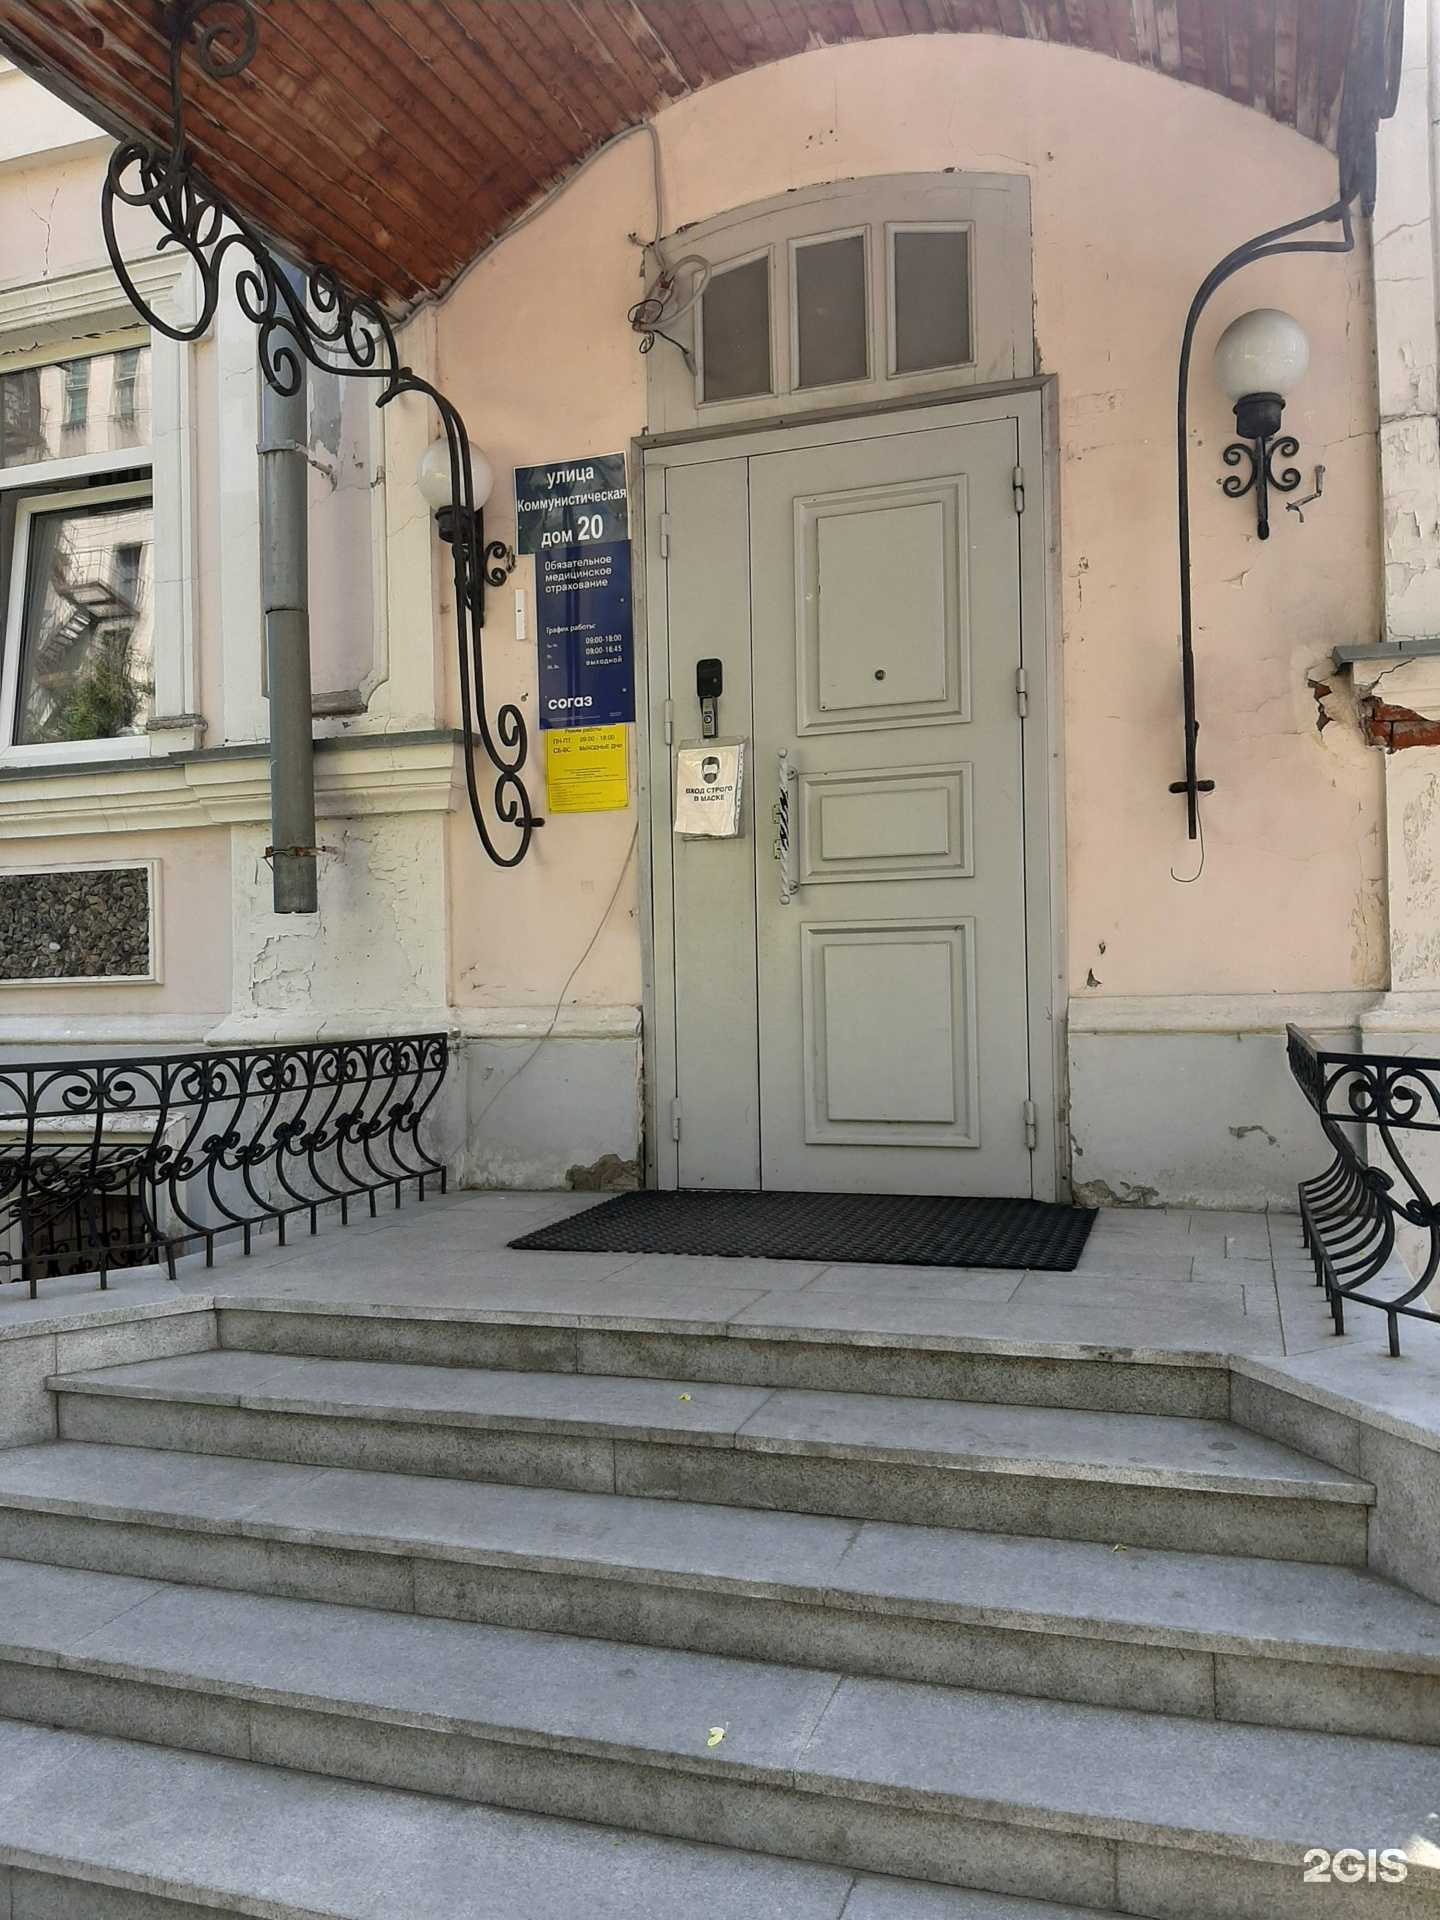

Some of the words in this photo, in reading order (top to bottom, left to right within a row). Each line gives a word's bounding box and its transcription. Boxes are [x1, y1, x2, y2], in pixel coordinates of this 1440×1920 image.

[547, 466, 594, 489] улица
[517, 488, 627, 513] Коммунистическая
[541, 529, 573, 549] дом
[577, 514, 603, 541] 20
[544, 556, 612, 571] Обязательное
[545, 567, 612, 582] медицинское
[545, 578, 608, 594] страхование
[548, 696, 593, 710] согаз
[685, 787, 704, 795] ВХОД
[706, 785, 733, 793] СТРОГО
